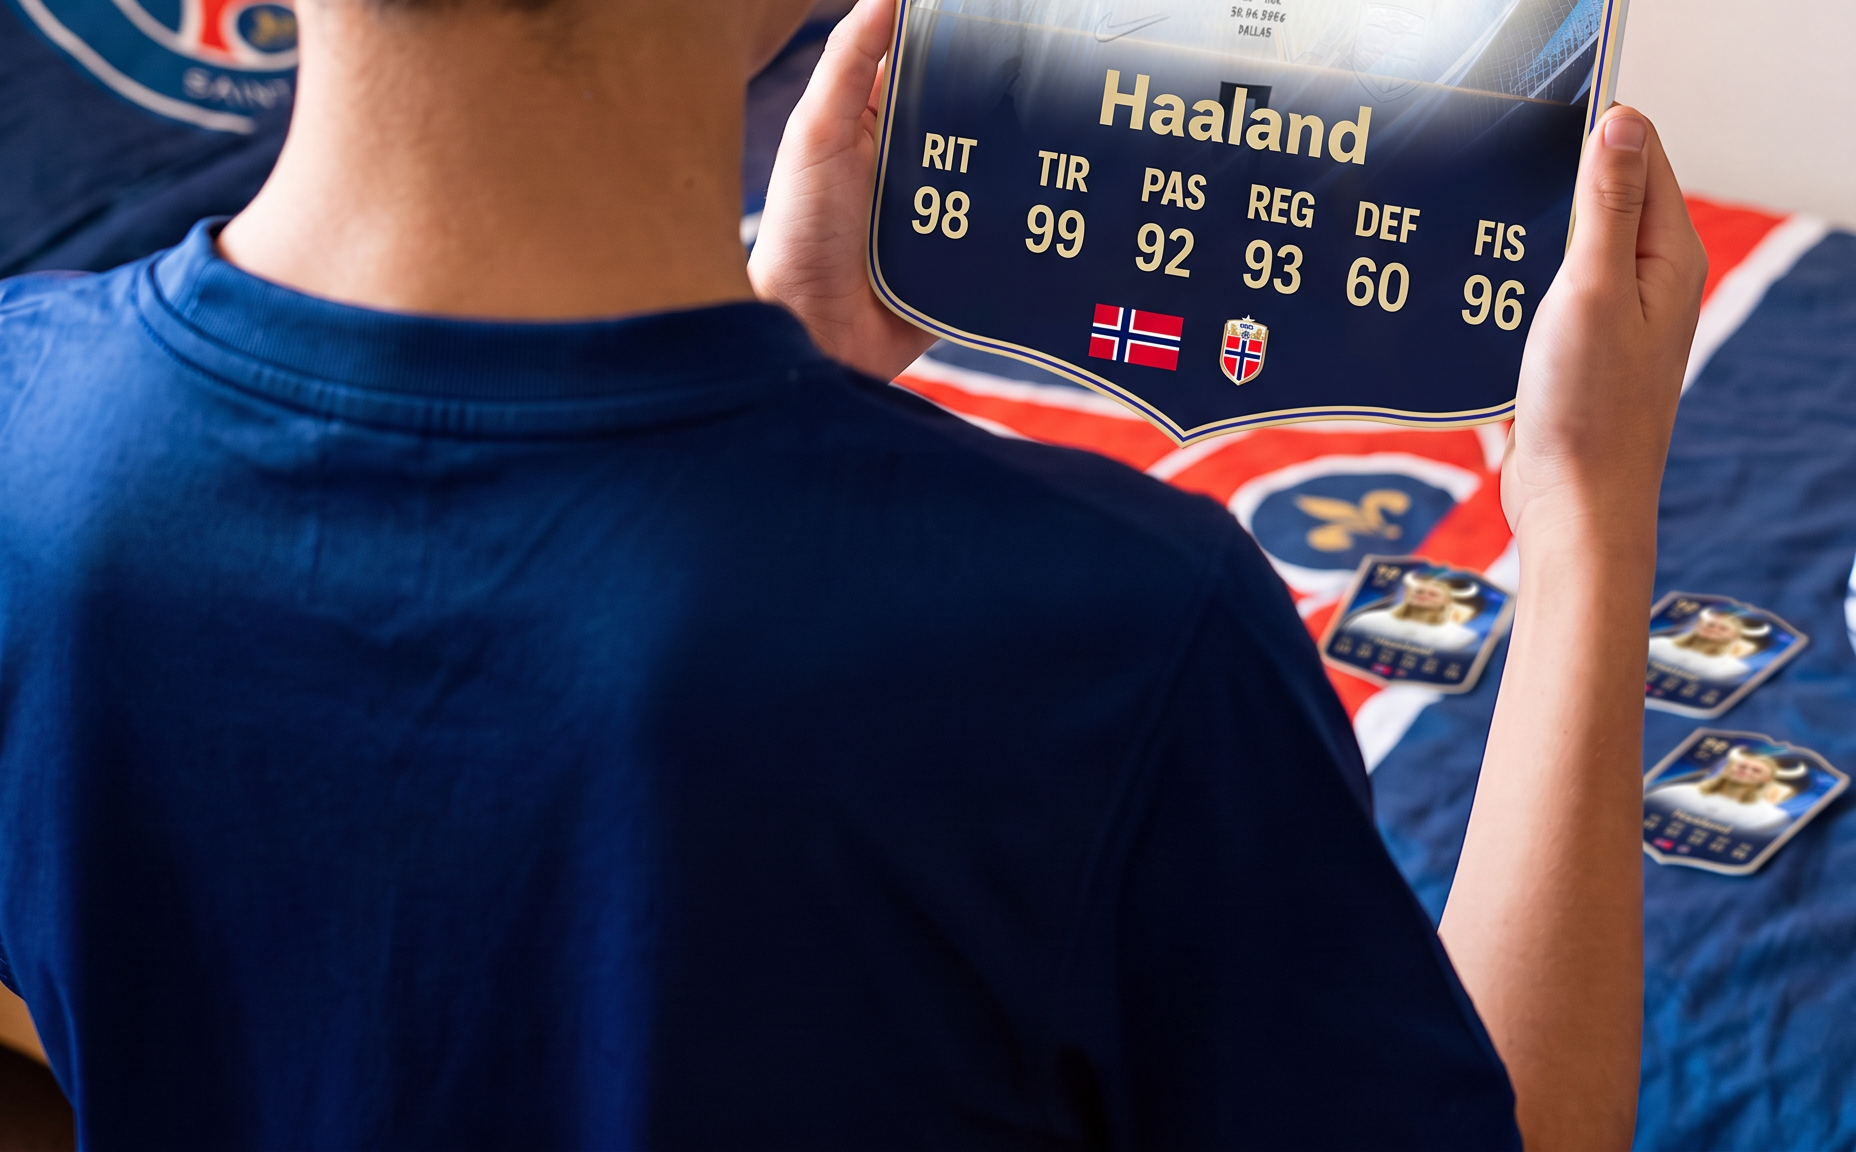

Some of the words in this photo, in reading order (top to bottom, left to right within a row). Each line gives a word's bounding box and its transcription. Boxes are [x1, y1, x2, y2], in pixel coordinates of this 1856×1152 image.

[1237, 24, 1272, 38] DALLAS
[1099, 68, 1373, 166] Haaland
[921, 132, 978, 174] RIT
[1037, 150, 1091, 193] TIR
[1140, 167, 1207, 211] PAS
[1246, 183, 1316, 229] REG
[1354, 200, 1421, 244] DEF
[1473, 219, 1527, 262] FIS
[911, 185, 971, 239] 98
[1024, 204, 1086, 259] 99
[1135, 223, 1196, 278] 92
[1242, 239, 1304, 295] 93
[1345, 256, 1410, 313] 60
[1461, 274, 1526, 331] 96
